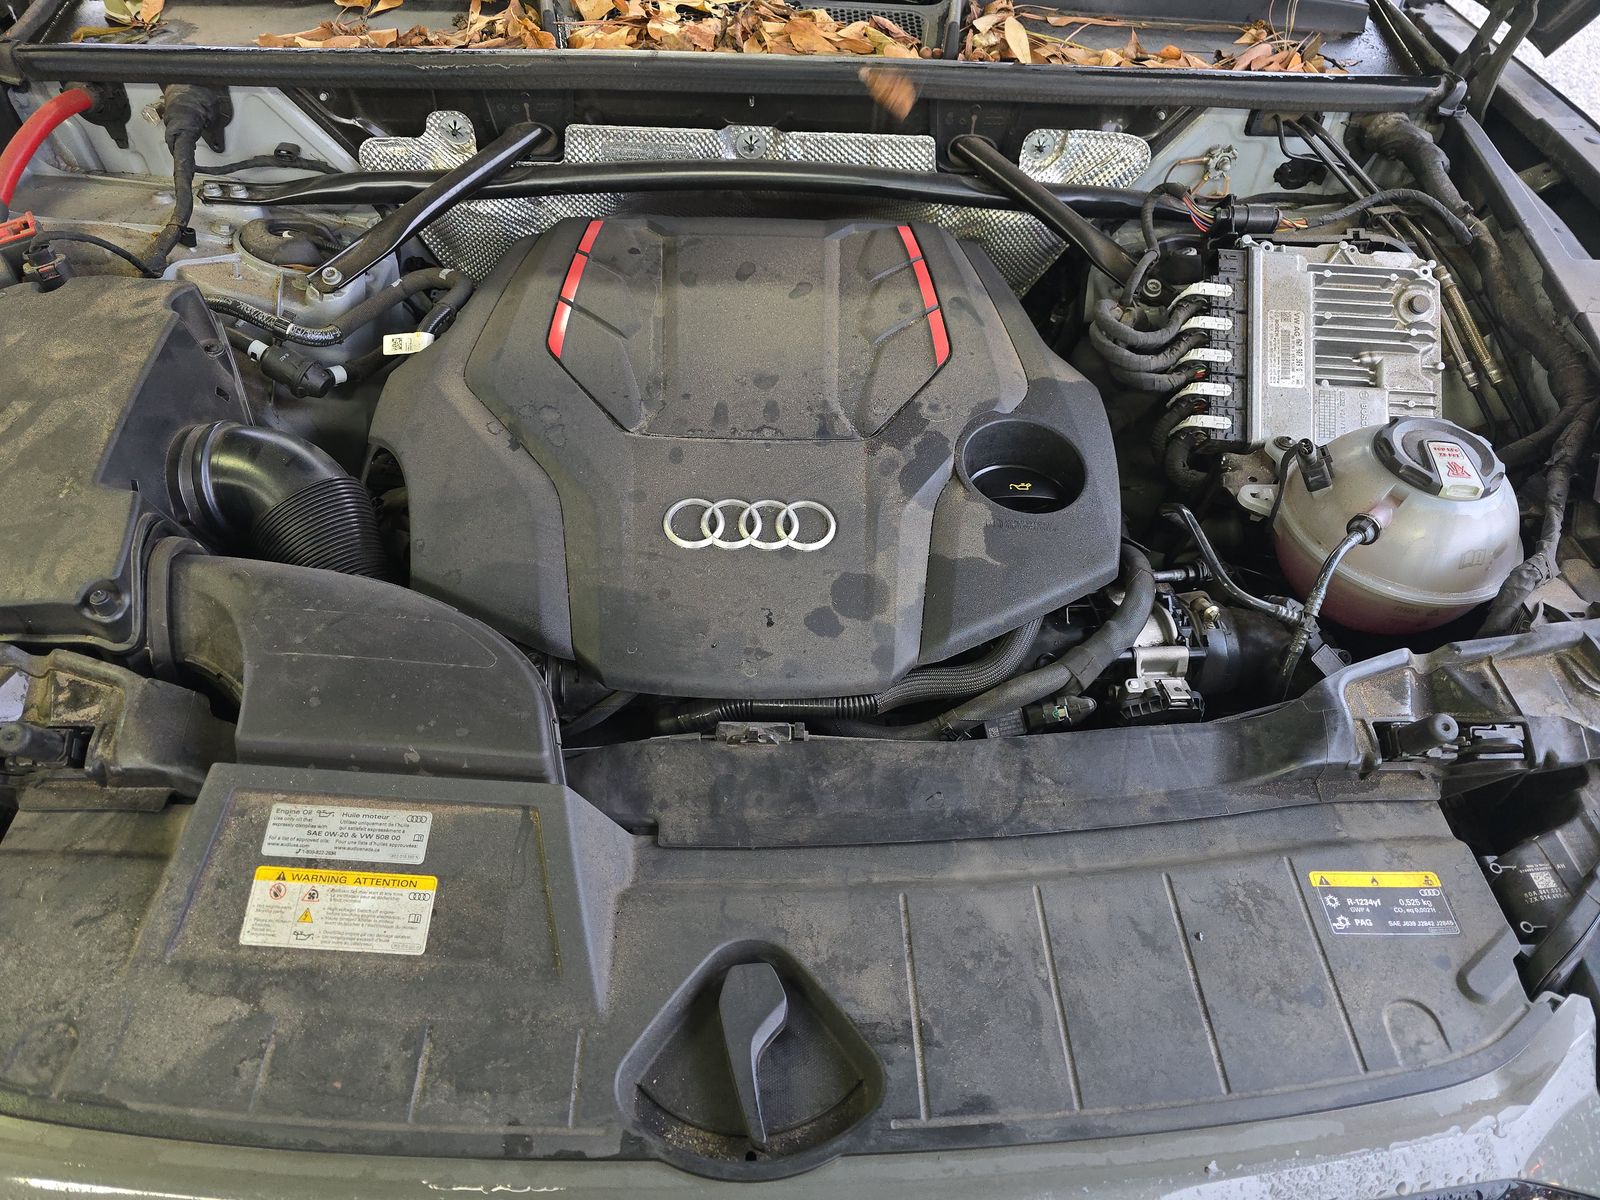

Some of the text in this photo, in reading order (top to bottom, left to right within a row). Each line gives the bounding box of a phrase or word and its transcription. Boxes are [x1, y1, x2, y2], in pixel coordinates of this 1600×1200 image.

[1294, 312, 1300, 324] VW
[1294, 326, 1301, 337] AG
[276, 808, 300, 816] Engine
[292, 873, 418, 888] WARNING ATTENTION
[1346, 898, 1381, 907] R-1234yf
[1421, 899, 1433, 907] kg
[1354, 918, 1373, 926] PAG
